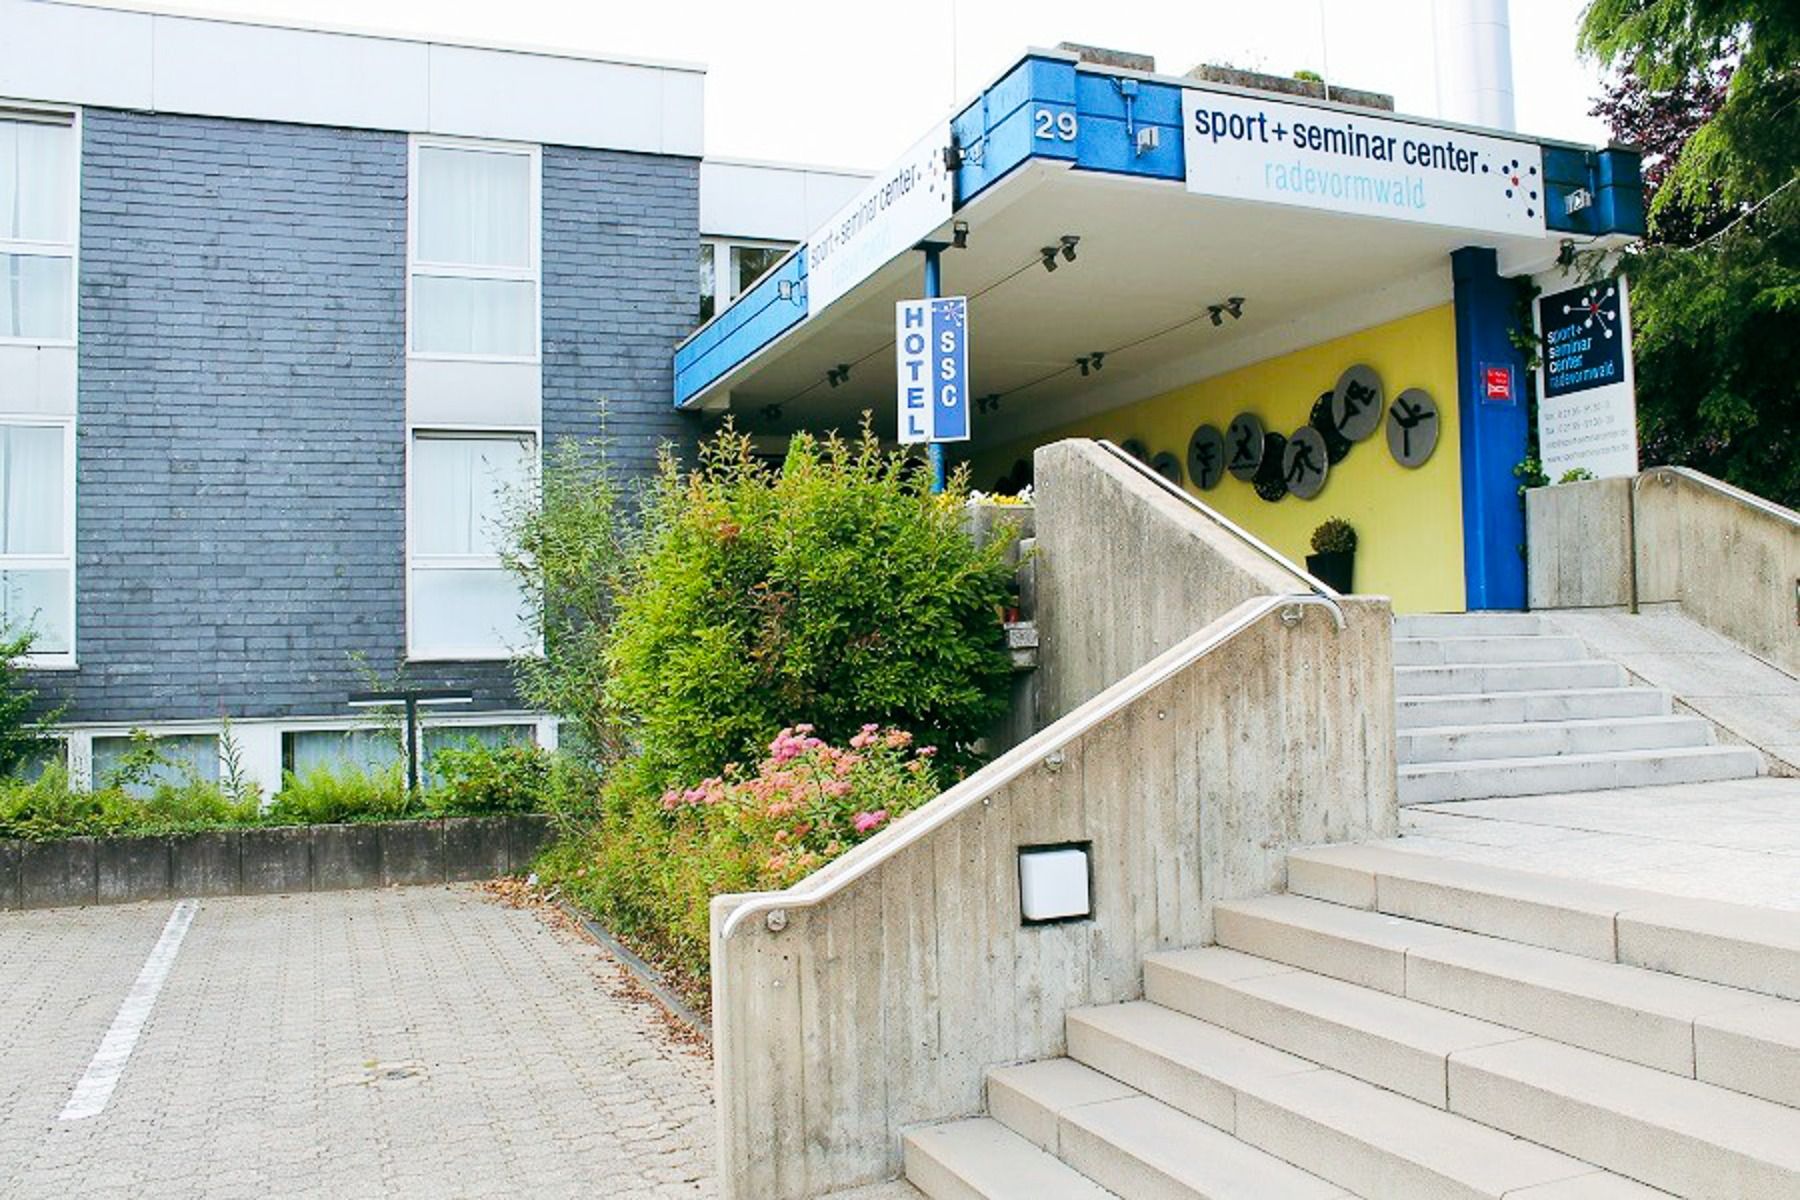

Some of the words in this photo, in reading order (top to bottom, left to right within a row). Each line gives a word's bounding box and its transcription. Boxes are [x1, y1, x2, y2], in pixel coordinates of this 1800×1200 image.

[1034, 108, 1078, 142] 29
[1402, 139, 1479, 174] center
[879, 163, 917, 211] center
[1264, 159, 1426, 209] radevormwald
[904, 307, 925, 436] HOTEL
[940, 330, 957, 408] SSC
[1548, 337, 1592, 359] seminar
